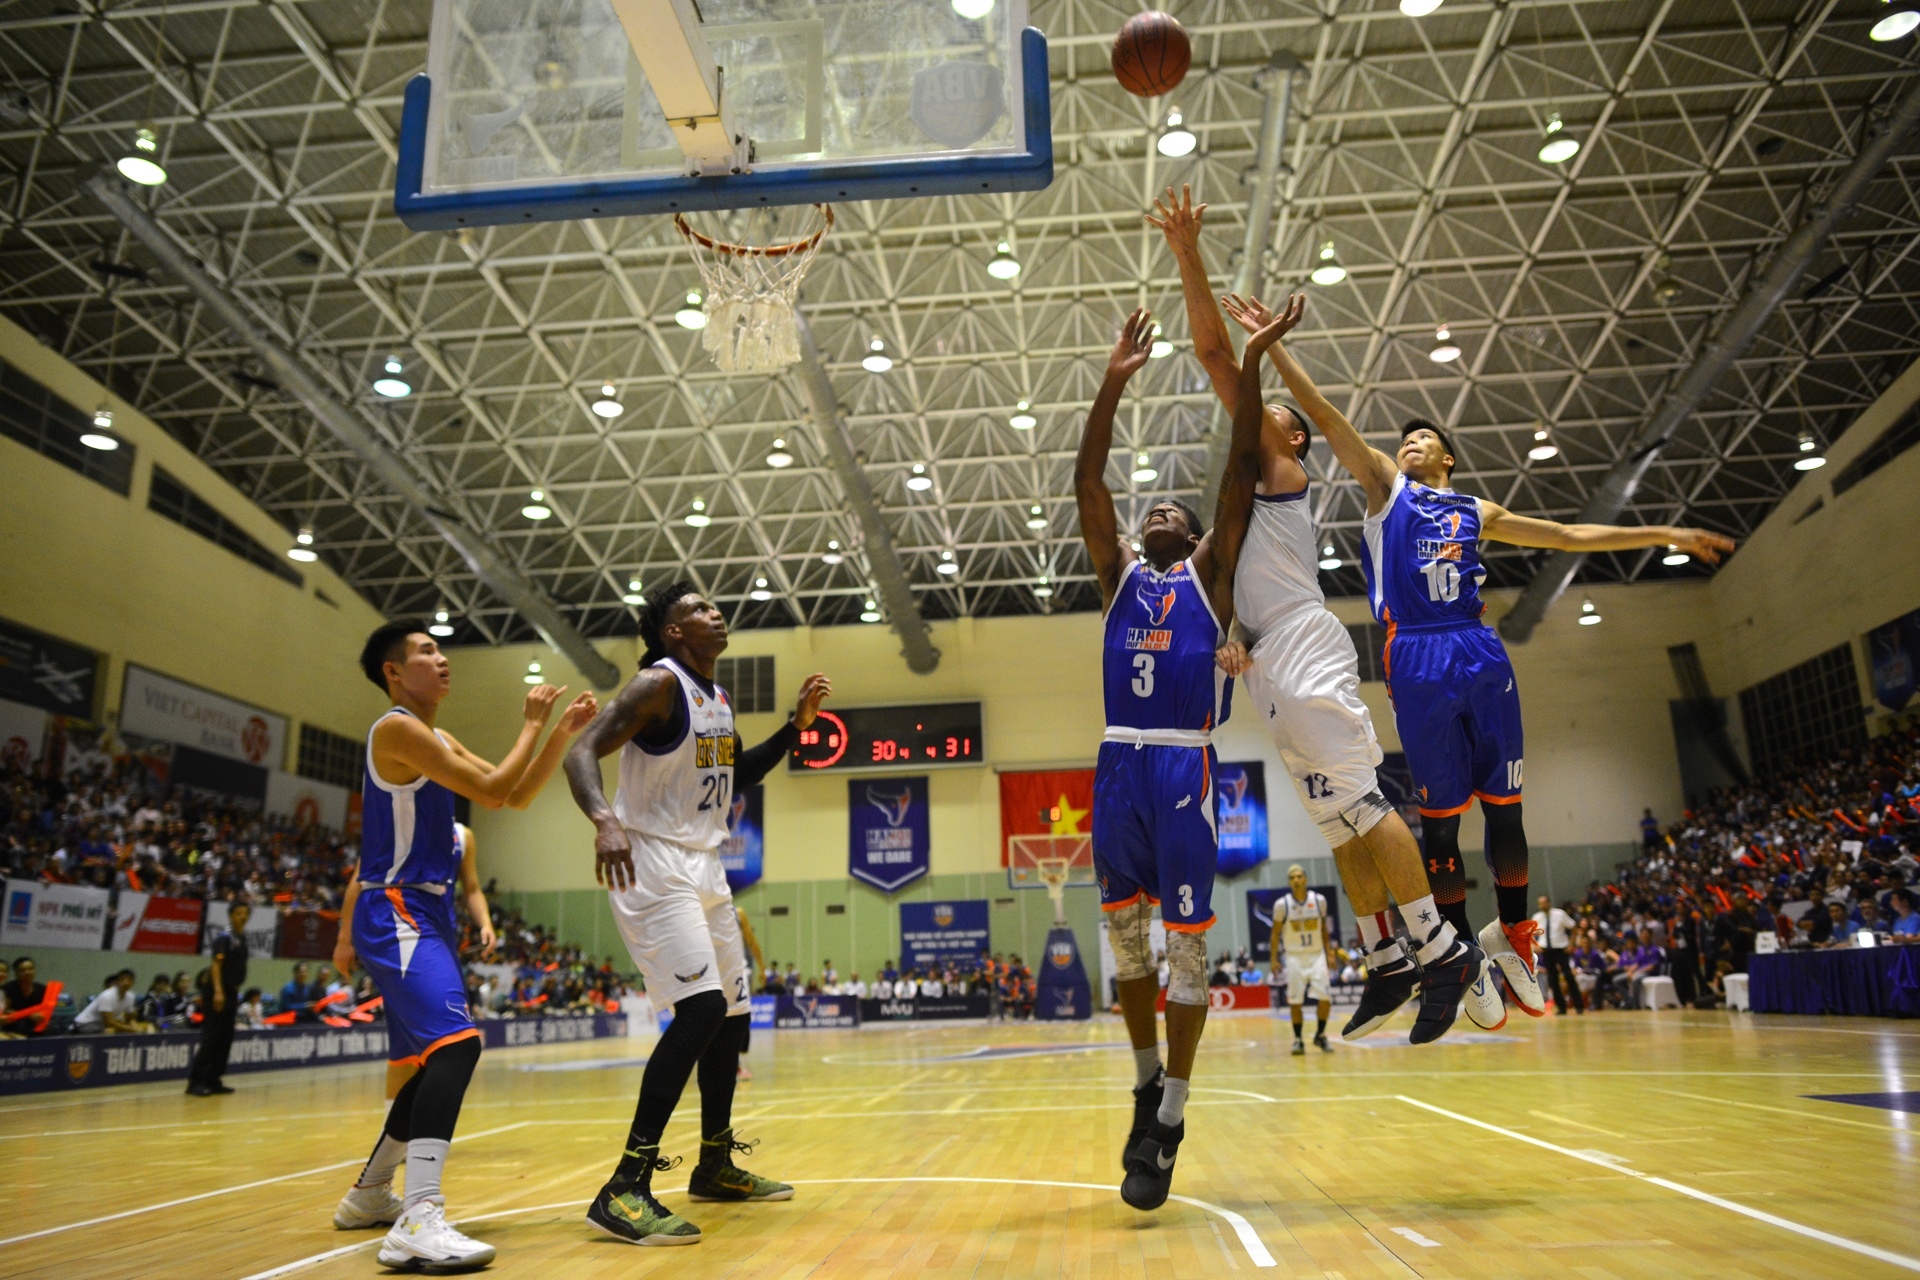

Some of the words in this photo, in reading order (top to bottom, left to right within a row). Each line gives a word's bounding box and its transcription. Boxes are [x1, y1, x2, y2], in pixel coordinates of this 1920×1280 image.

[1420, 562, 1461, 602] 10
[1127, 629, 1172, 643] HANOI
[1131, 653, 1155, 698] 3
[872, 739, 897, 762] 30
[900, 747, 911, 760] 4
[926, 746, 937, 758] 4
[946, 737, 971, 758] 31
[1304, 773, 1334, 799] 12
[1507, 759, 1523, 790] 10
[698, 773, 729, 812] 20
[1178, 884, 1194, 917] 3
[1301, 934, 1312, 947] 11
